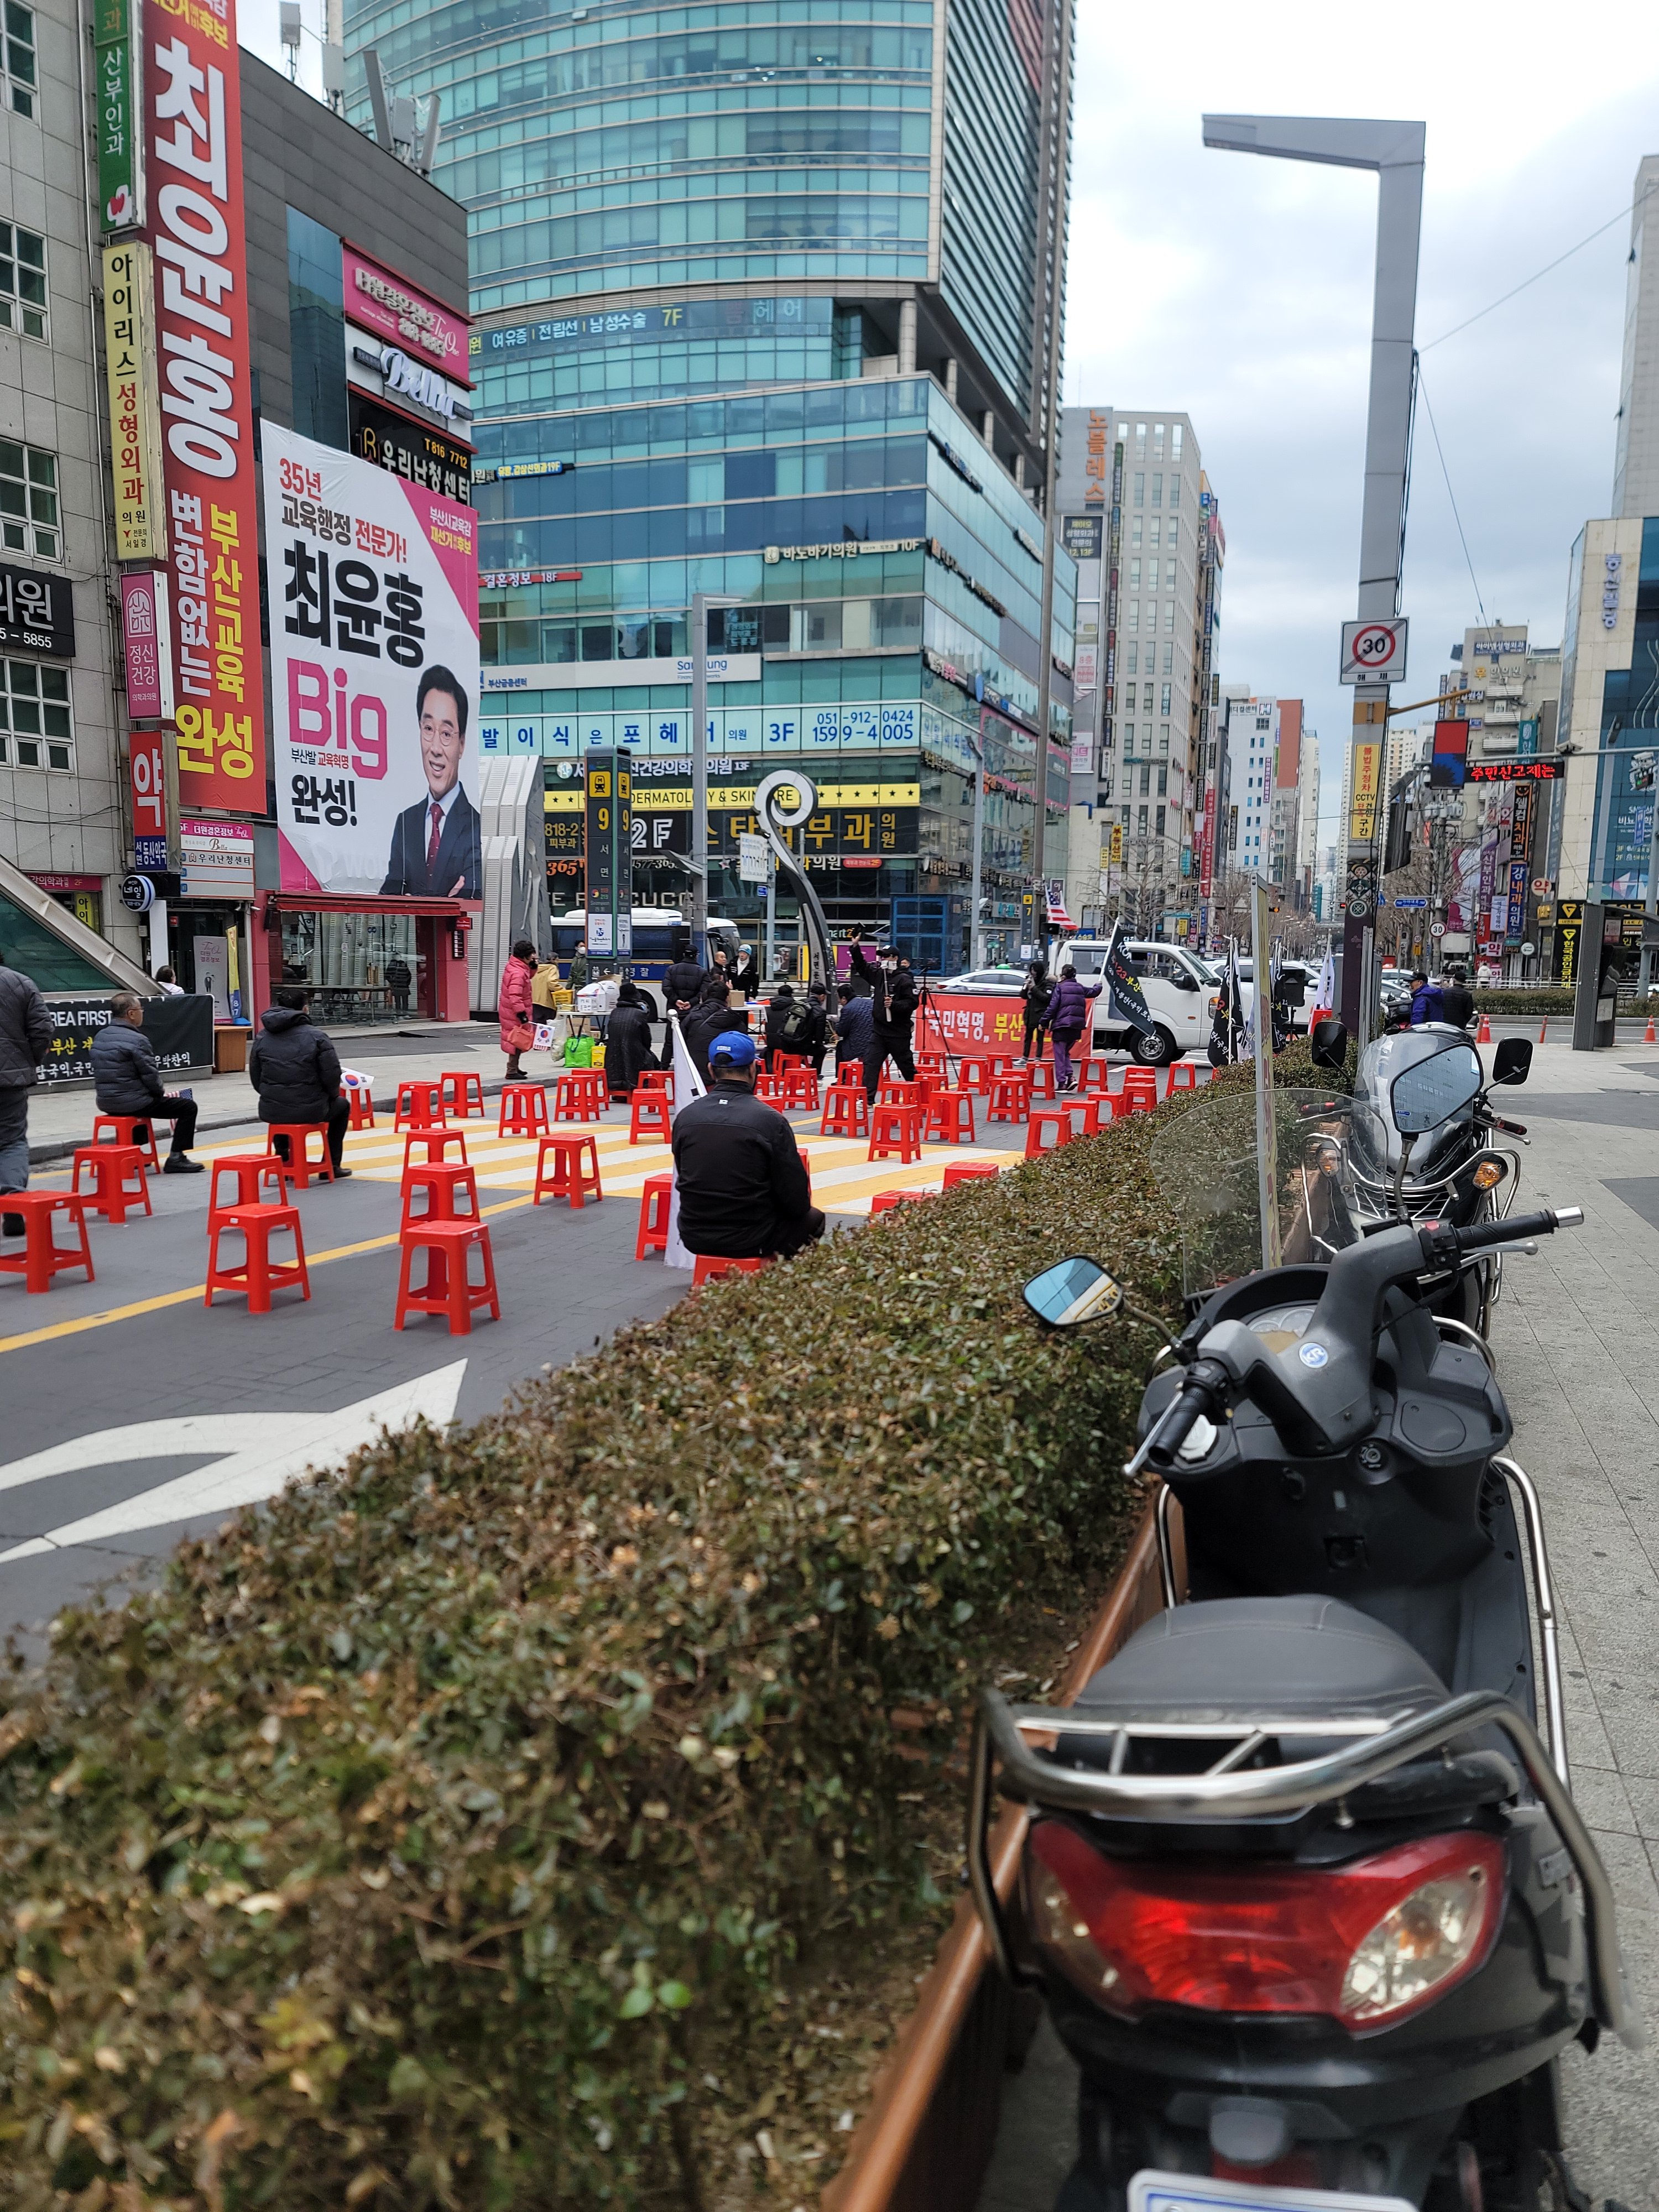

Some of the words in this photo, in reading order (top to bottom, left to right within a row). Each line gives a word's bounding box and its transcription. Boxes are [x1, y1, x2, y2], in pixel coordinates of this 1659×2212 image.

[103, 46, 124, 155] 산부인과
[155, 36, 239, 478] 최윤홍
[491, 327, 528, 348] 여유증
[538, 319, 578, 341] 전립선
[589, 311, 647, 333] 남성수술
[661, 308, 684, 326] 7F
[1084, 409, 1108, 501] 노블레스
[279, 457, 321, 502] 35년
[382, 440, 471, 506] 우리난청센터
[122, 510, 147, 525] 의원
[281, 493, 351, 546] 교육행정
[354, 518, 408, 564] 전문가!
[430, 506, 472, 538] 부산시교육감
[171, 489, 211, 697] 변함없는
[210, 504, 245, 703] 부산교육
[284, 539, 425, 669] 최윤홍
[129, 644, 154, 665] 정신
[1362, 638, 1386, 654] 30
[131, 666, 156, 686] 건강
[677, 660, 727, 671] Saung
[488, 677, 528, 688] 부산금융센터
[132, 692, 157, 702] 의학과의원
[286, 657, 388, 781] Big
[175, 705, 254, 779] 완성
[728, 729, 747, 740] 의원
[769, 723, 795, 742] 3F
[291, 748, 317, 766] 부산발
[317, 750, 349, 770] 교육혁명
[1361, 746, 1373, 792] 불법주정차
[1471, 764, 1557, 781] 주민신고제는
[134, 748, 163, 828] 약
[1355, 793, 1375, 802] CCTV
[291, 774, 358, 827] 완성!
[598, 807, 609, 830] 9
[622, 809, 629, 832] 9
[1359, 819, 1369, 837] 구간
[194, 825, 234, 836] 더원결혼정보
[880, 813, 896, 849] 의원
[549, 838, 577, 849] 피부과
[199, 853, 251, 866] 우리난청센터
[123, 886, 142, 899] 네일
[1509, 867, 1525, 927] 강내과의원
[1534, 880, 1549, 894] 약
[1488, 943, 1500, 955] 약
[52, 1010, 76, 1027] REA
[77, 1010, 112, 1026] FIRST
[50, 1037, 77, 1056] 부산
